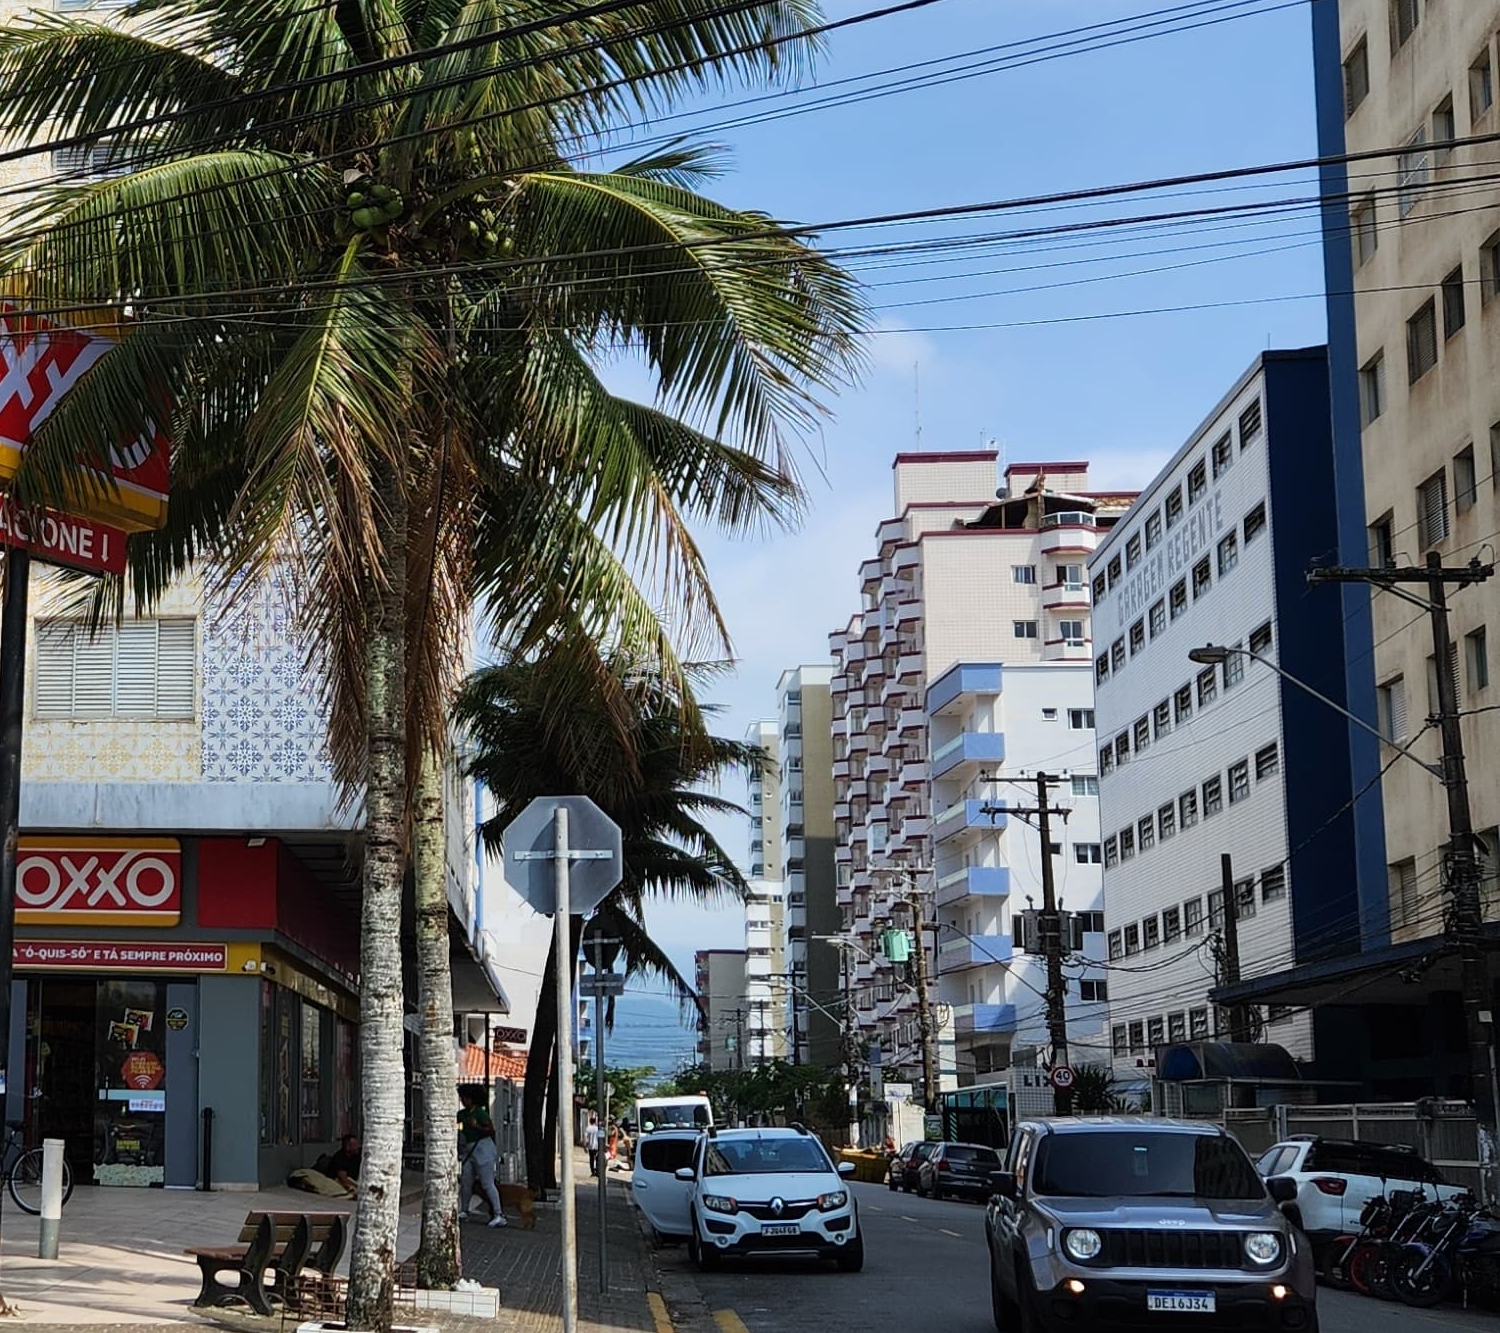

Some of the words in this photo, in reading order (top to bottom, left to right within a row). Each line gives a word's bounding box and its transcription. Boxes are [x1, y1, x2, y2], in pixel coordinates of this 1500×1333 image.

[1118, 549, 1165, 626] GARAGEM
[1167, 489, 1223, 580] REGENTE
[15, 850, 175, 911] OXXO
[94, 950, 101, 959] E
[102, 947, 118, 960] TÁ
[120, 950, 166, 961] SEMPRE
[168, 949, 223, 962] PRÓXIMO
[497, 1028, 525, 1040] OXXO
[1056, 1071, 1070, 1080] 40
